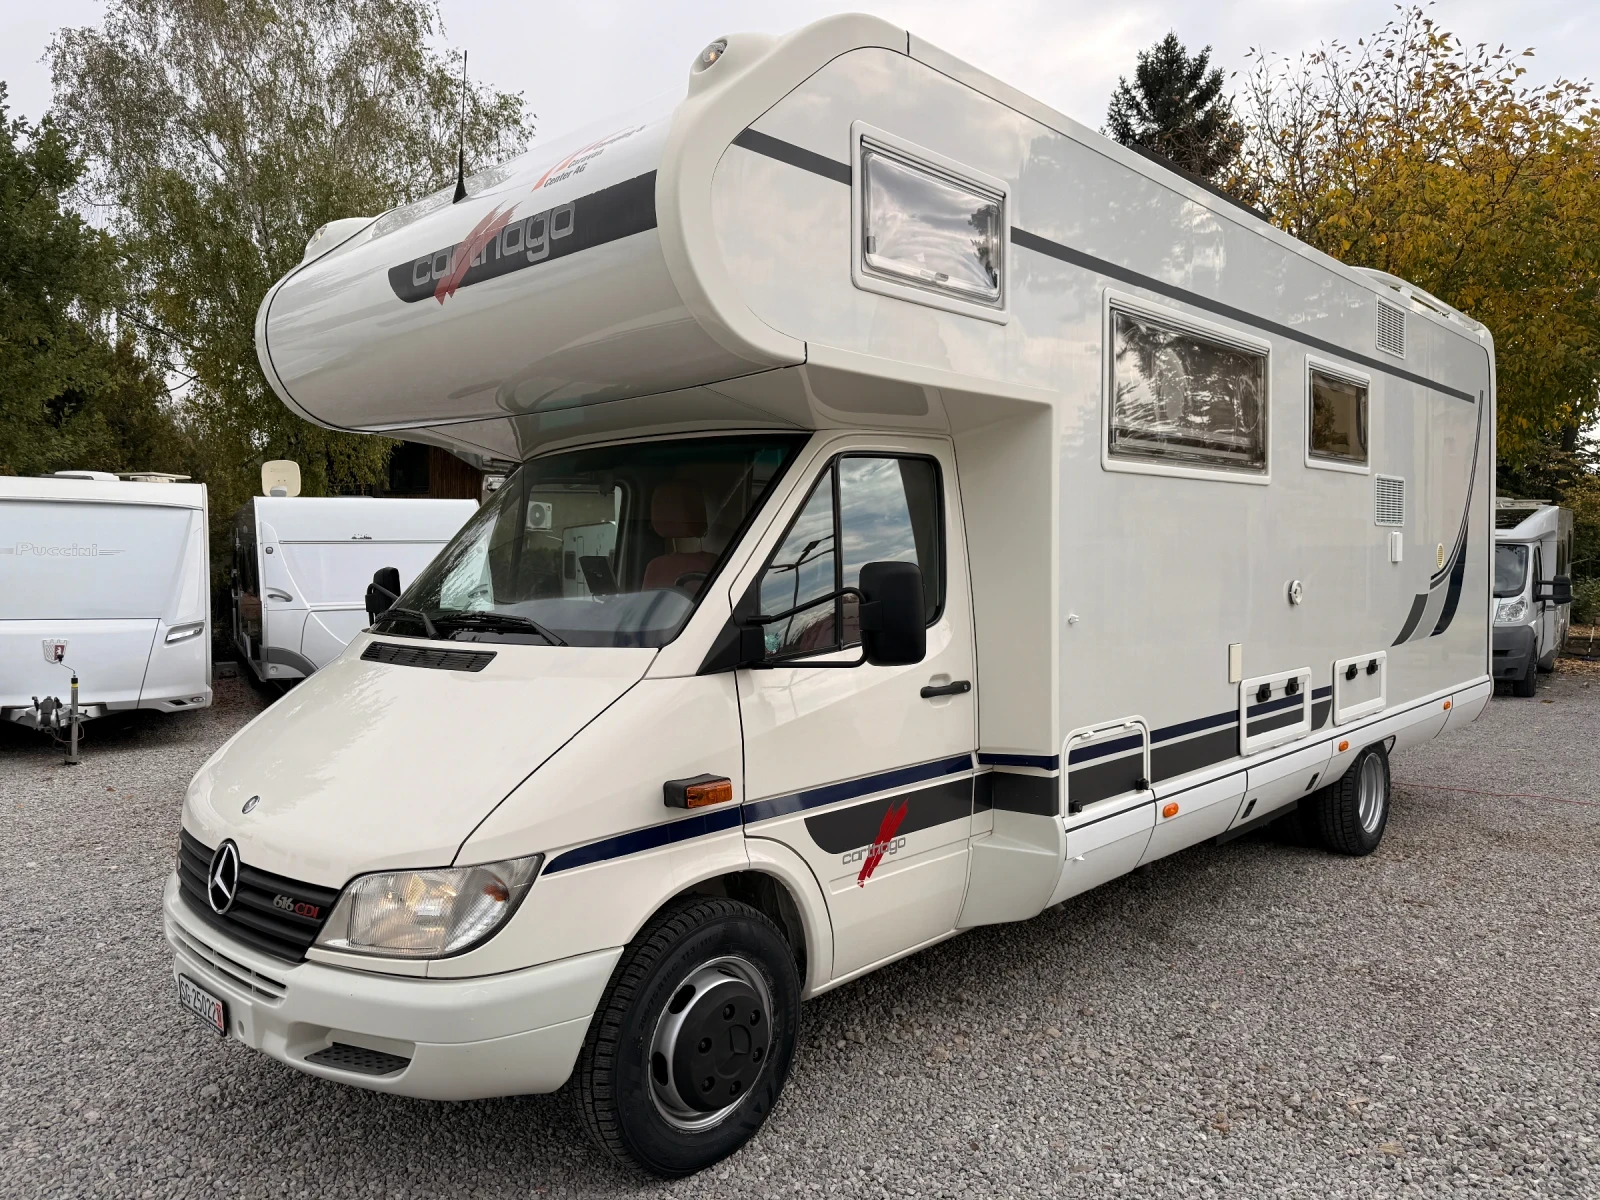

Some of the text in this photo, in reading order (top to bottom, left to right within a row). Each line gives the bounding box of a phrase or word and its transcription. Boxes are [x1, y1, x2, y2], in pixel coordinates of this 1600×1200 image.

[543, 162, 588, 188] Center AG
[412, 201, 576, 287] carthago
[15, 542, 98, 557] Puccini
[842, 836, 906, 865] carthago
[273, 894, 320, 918] 616 CDI
